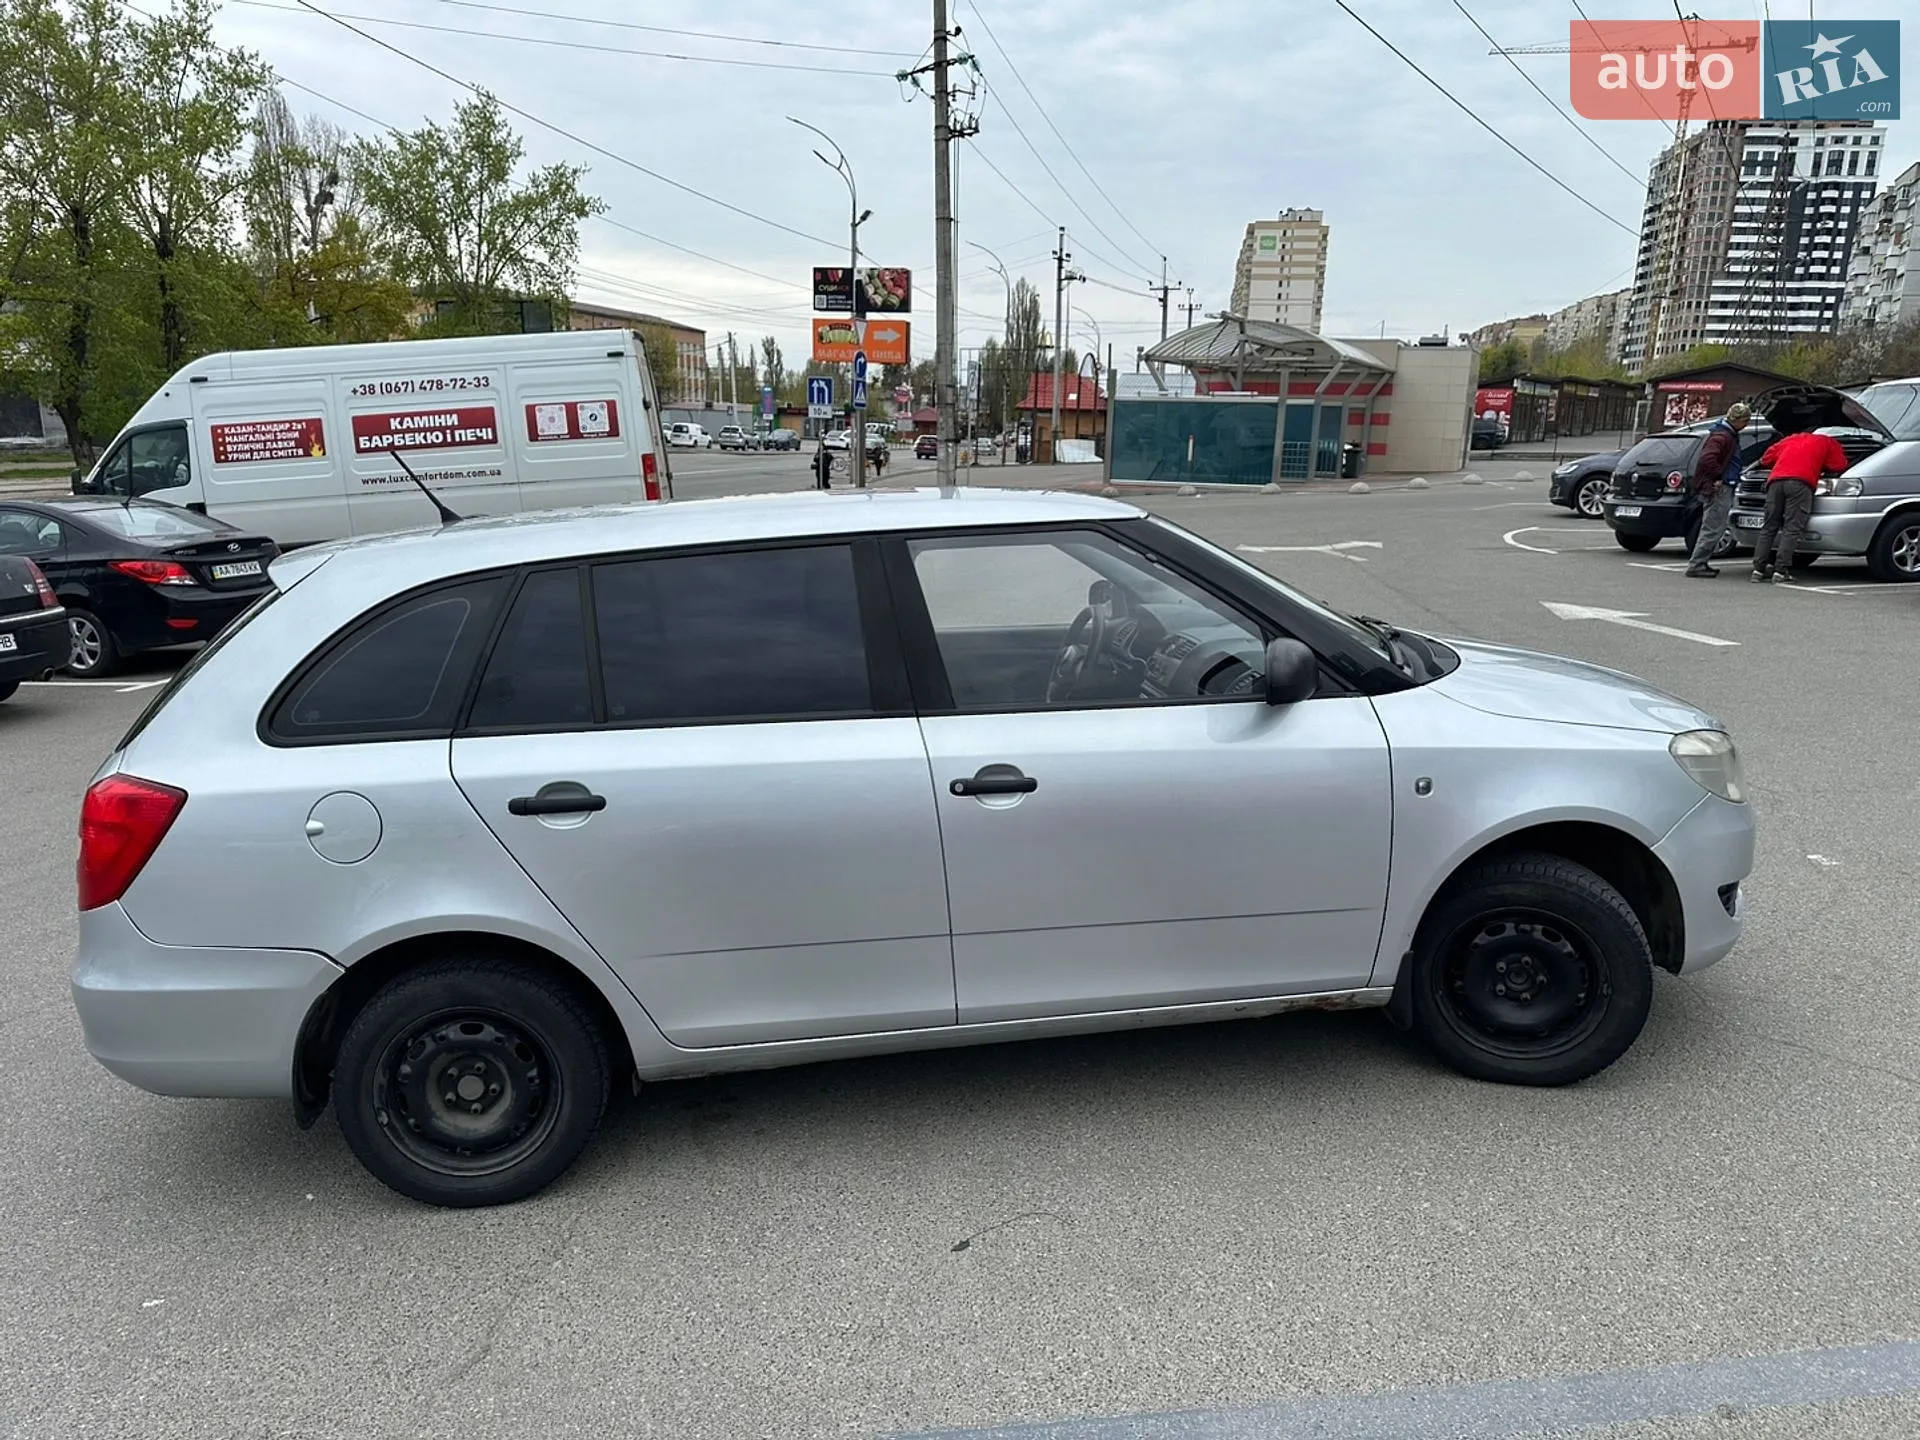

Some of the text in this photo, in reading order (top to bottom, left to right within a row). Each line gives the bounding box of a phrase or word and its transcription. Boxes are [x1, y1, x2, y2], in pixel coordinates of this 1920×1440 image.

[351, 376, 490, 396] +38 (067) 478-72-33
[223, 423, 291, 434] КАЗАН-ТАНДИР
[389, 414, 459, 430] КАМІНИ
[225, 431, 300, 443] МАНГАЛЬНІ ЗОНИ
[358, 430, 444, 449] БАРБЕКЮ
[454, 427, 493, 442] ПЕЧІ
[226, 440, 296, 452] ВУЛИЧНІ ЛАВКИ
[227, 448, 304, 461] УРНИ ДЛЯ СМІТТЯ
